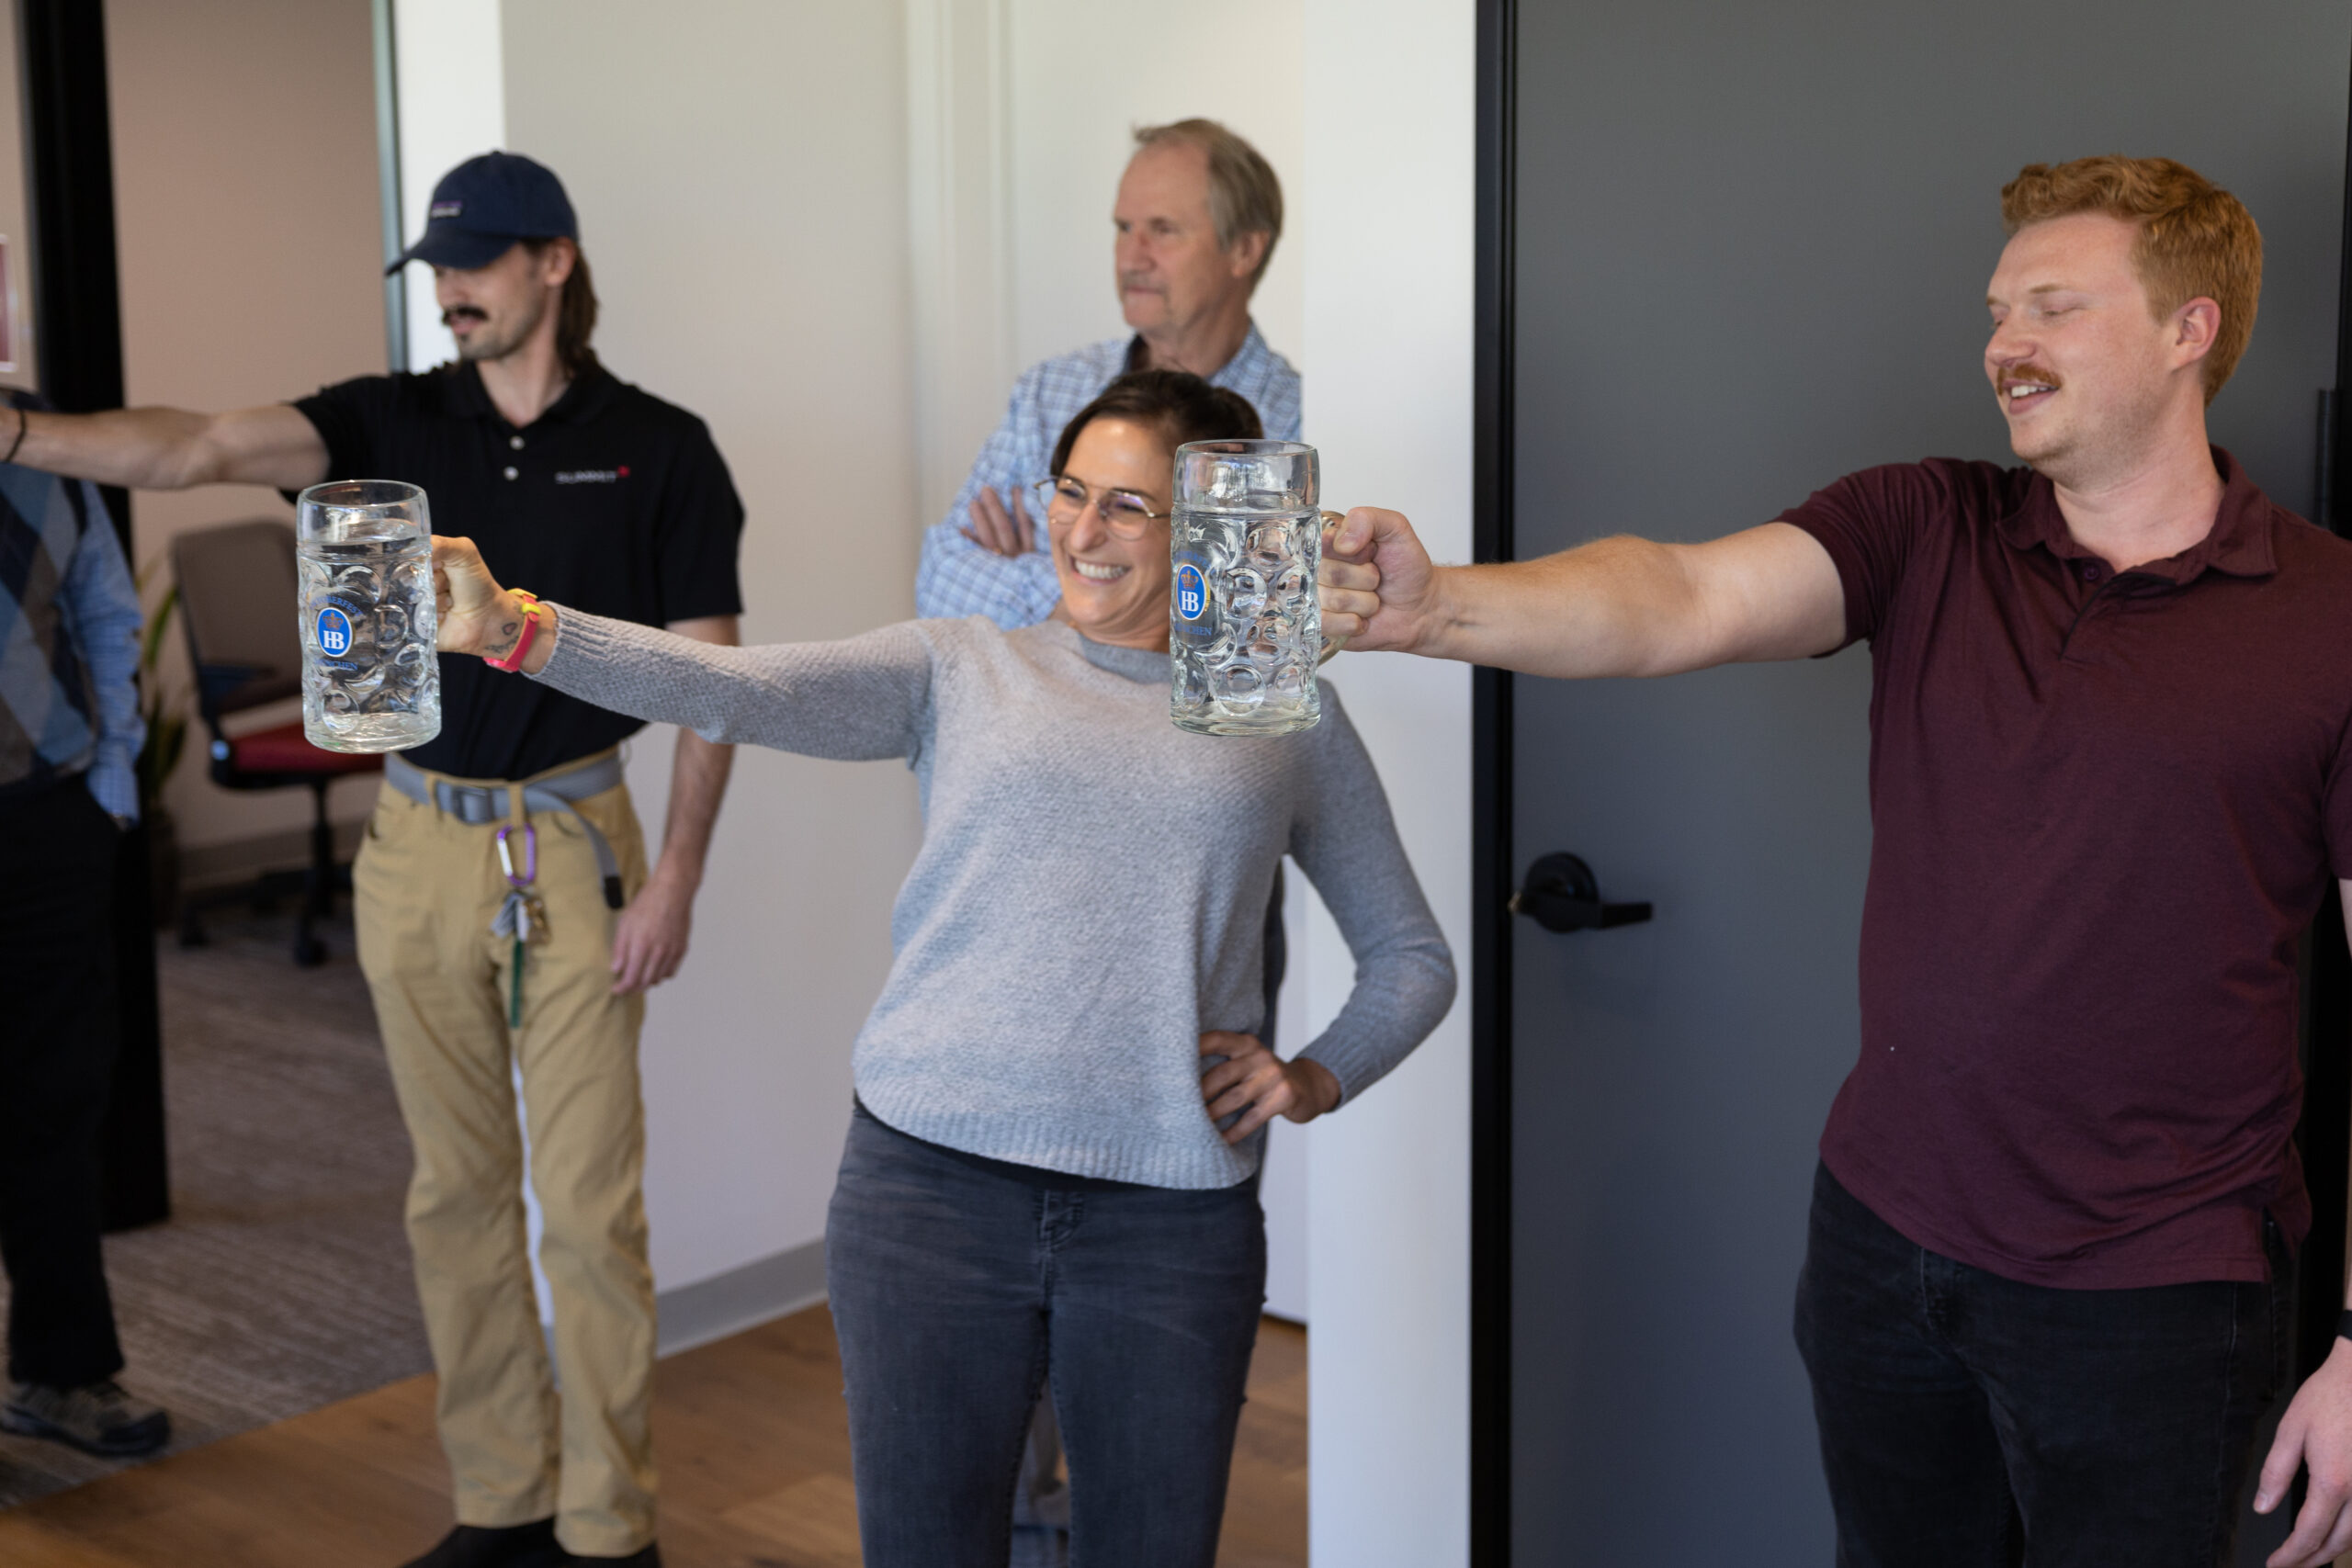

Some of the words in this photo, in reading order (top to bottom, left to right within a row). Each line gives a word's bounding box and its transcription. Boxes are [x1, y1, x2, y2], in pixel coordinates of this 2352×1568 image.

[309, 594, 364, 616] BERFEST
[1181, 590, 1199, 612] HB
[322, 629, 345, 649] HB
[1174, 624, 1212, 636] CHEN
